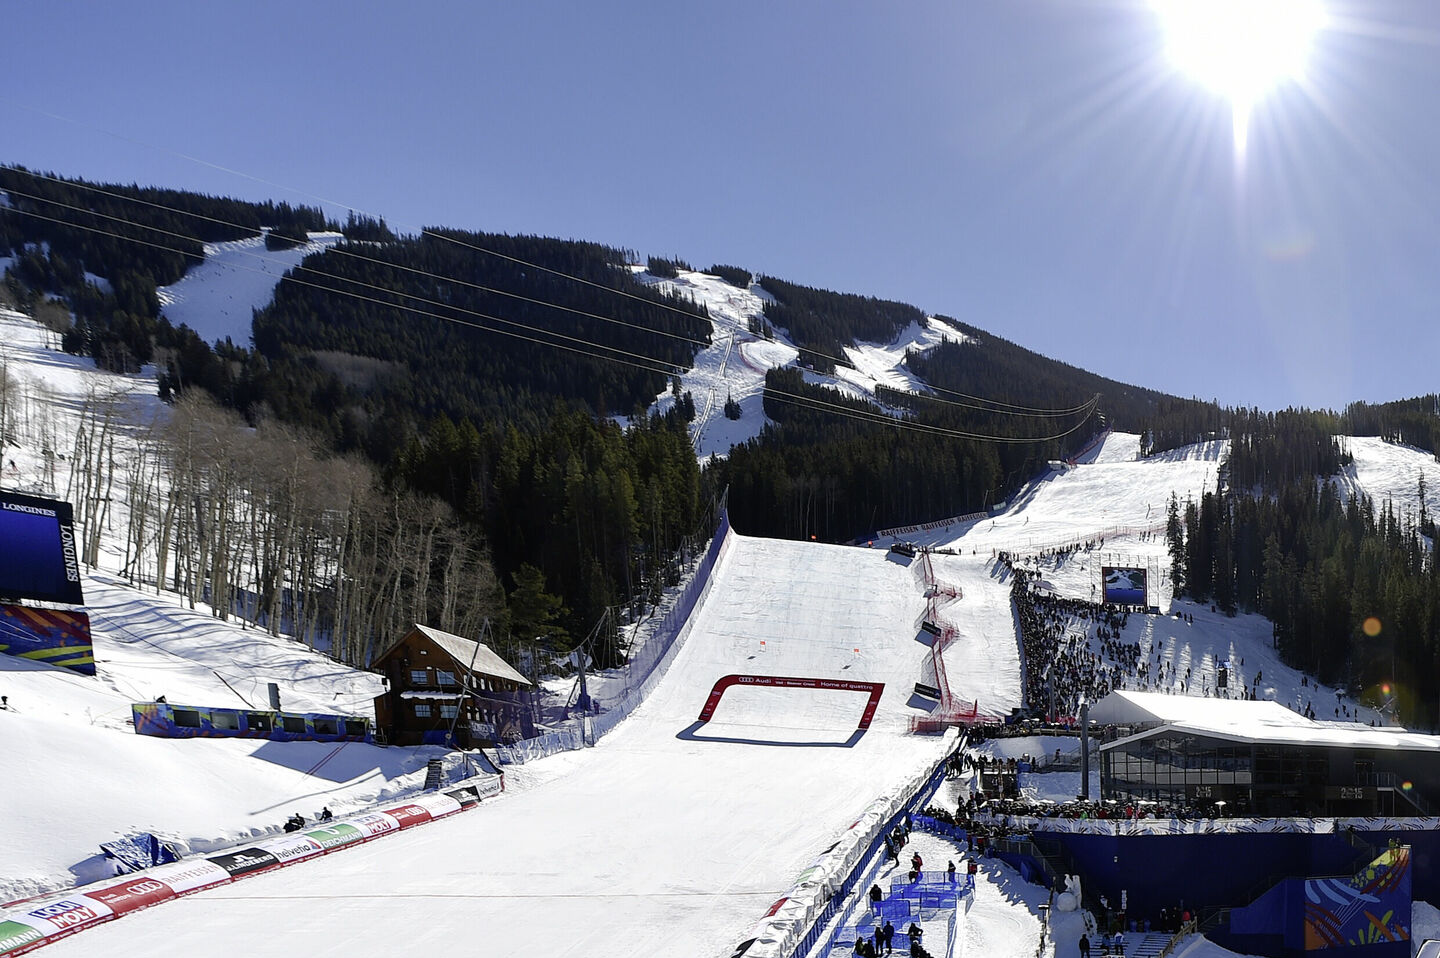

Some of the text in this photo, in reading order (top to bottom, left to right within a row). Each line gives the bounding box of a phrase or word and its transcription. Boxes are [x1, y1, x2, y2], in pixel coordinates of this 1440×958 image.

[2, 502, 57, 517] LONGINES
[881, 526, 919, 537] RAIFFEISEN
[60, 524, 79, 582] LONGINES
[849, 683, 874, 691] quattro
[322, 830, 363, 848] DEICHMANN
[276, 844, 311, 860] helvetia
[30, 900, 83, 919] LIQUI
[51, 906, 95, 928] MOLY
